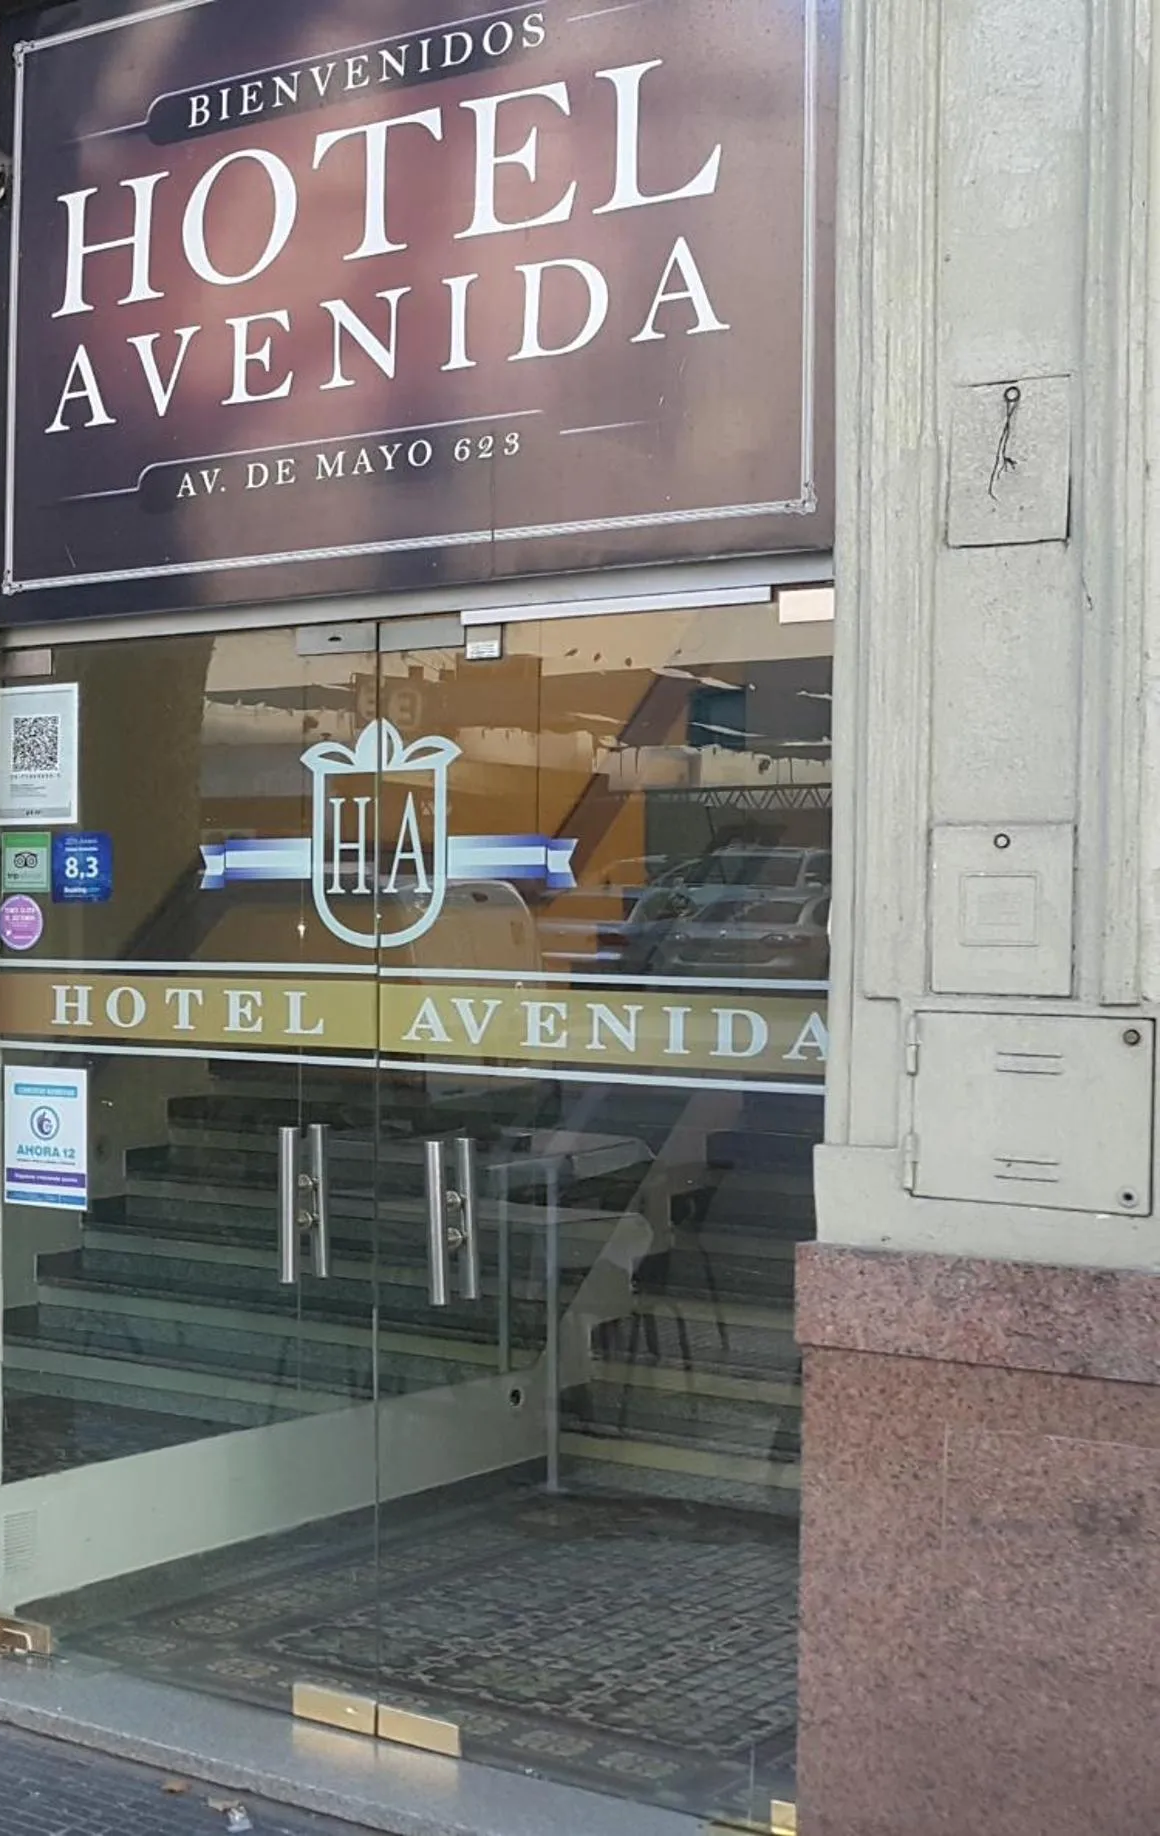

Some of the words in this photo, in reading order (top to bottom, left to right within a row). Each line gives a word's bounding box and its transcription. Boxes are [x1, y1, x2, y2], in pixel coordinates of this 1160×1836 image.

[187, 12, 546, 129] BIENVENIDOS
[51, 59, 722, 319] HOTEL
[44, 235, 731, 434] AVENIDA
[176, 468, 227, 498] AV.
[245, 458, 296, 489] DE
[315, 439, 433, 480] MAYO
[453, 432, 521, 463] 623
[64, 855, 99, 880] 8,3
[50, 985, 325, 1035] HOTEL
[401, 996, 829, 1062] AVENIDA
[16, 1143, 61, 1158] AHORA
[63, 1147, 77, 1160] 12
